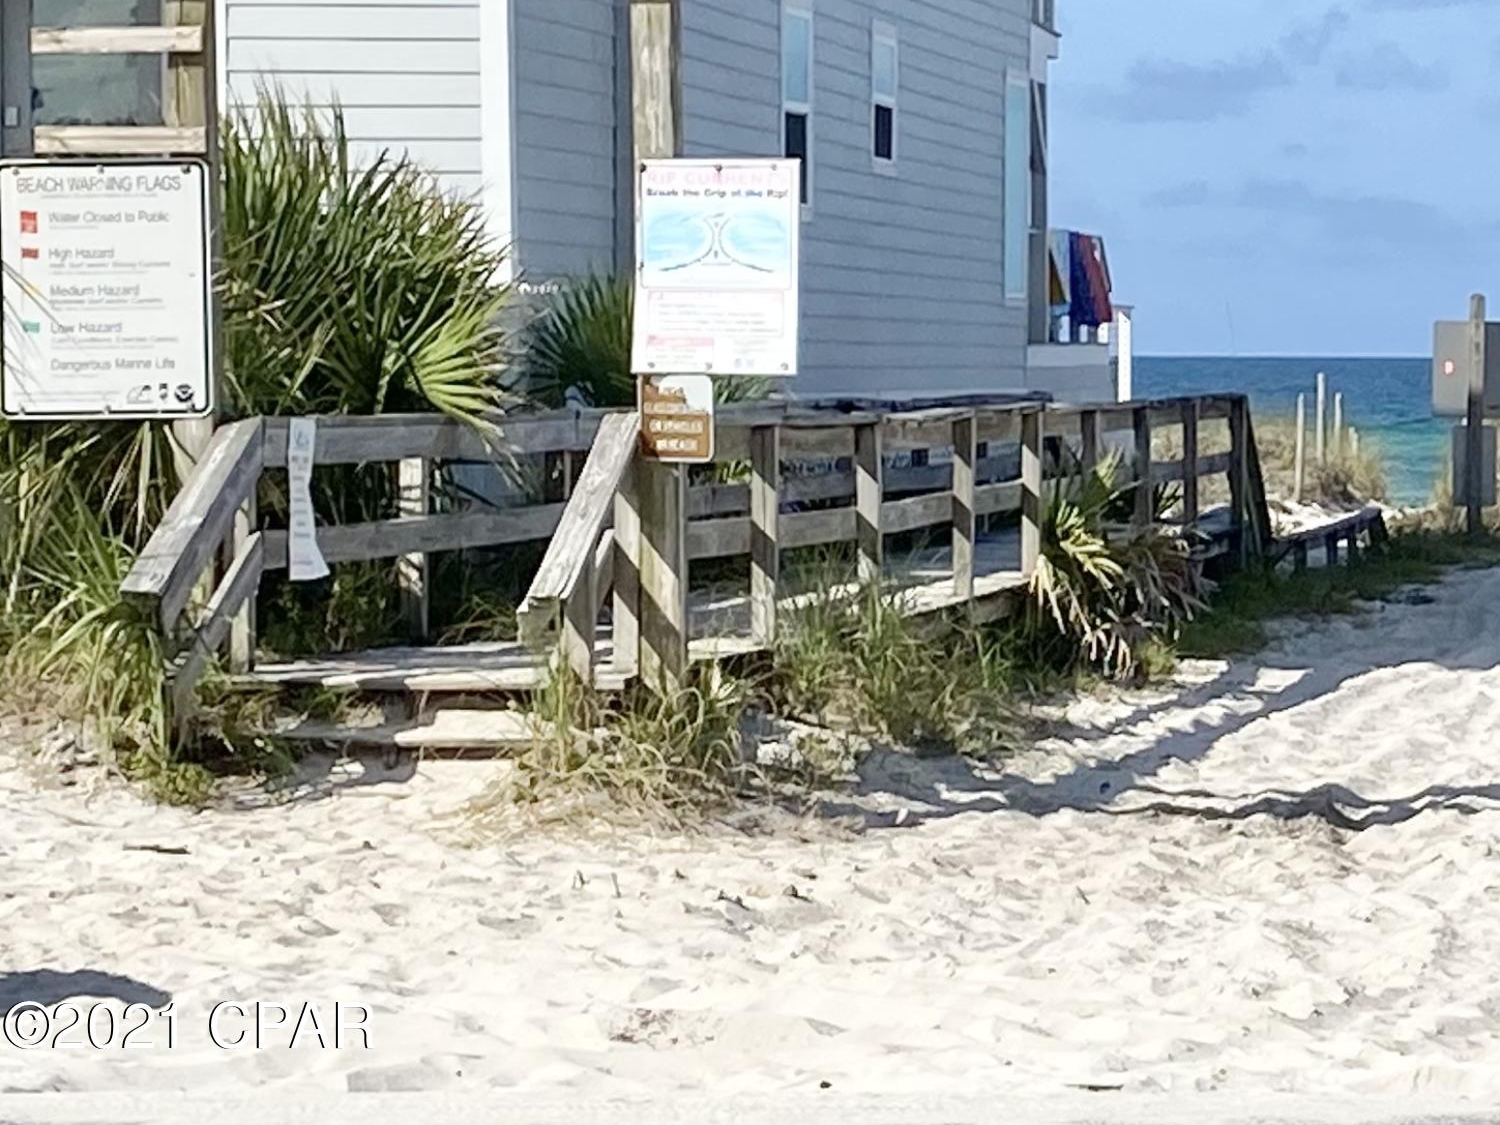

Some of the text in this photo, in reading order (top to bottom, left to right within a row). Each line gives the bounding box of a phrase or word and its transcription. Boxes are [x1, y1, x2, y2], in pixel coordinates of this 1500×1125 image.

[17, 177, 64, 193] BEACH
[136, 176, 181, 191] FLAGS
[704, 189, 727, 199] Grip
[84, 211, 121, 223] Closed
[125, 212, 136, 222] to
[138, 211, 170, 222] Public
[49, 248, 114, 262] High Hazard
[50, 285, 139, 296] Medium Hazard
[50, 322, 122, 333] Low Hazard
[51, 359, 111, 372] Dangerous
[155, 358, 175, 369] Life
